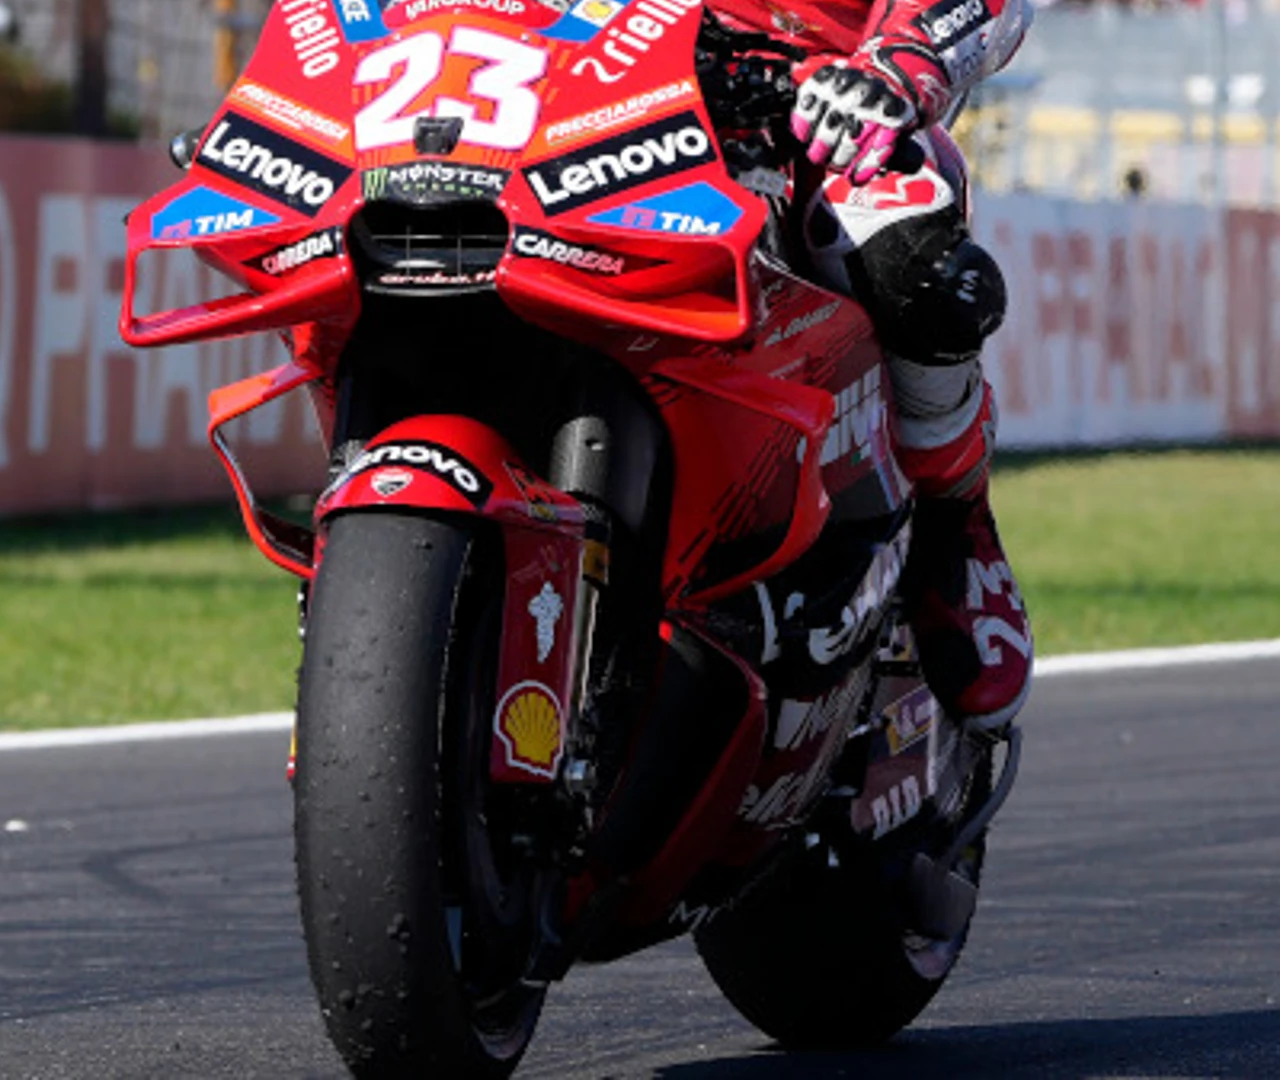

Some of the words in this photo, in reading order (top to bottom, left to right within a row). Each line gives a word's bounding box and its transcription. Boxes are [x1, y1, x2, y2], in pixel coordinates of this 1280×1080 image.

[353, 25, 550, 153] 23
[201, 120, 335, 206] Lenovo
[527, 126, 709, 207] Lenovo
[195, 208, 255, 235] TIM
[659, 211, 721, 235] TIM
[966, 558, 1032, 666] 23
